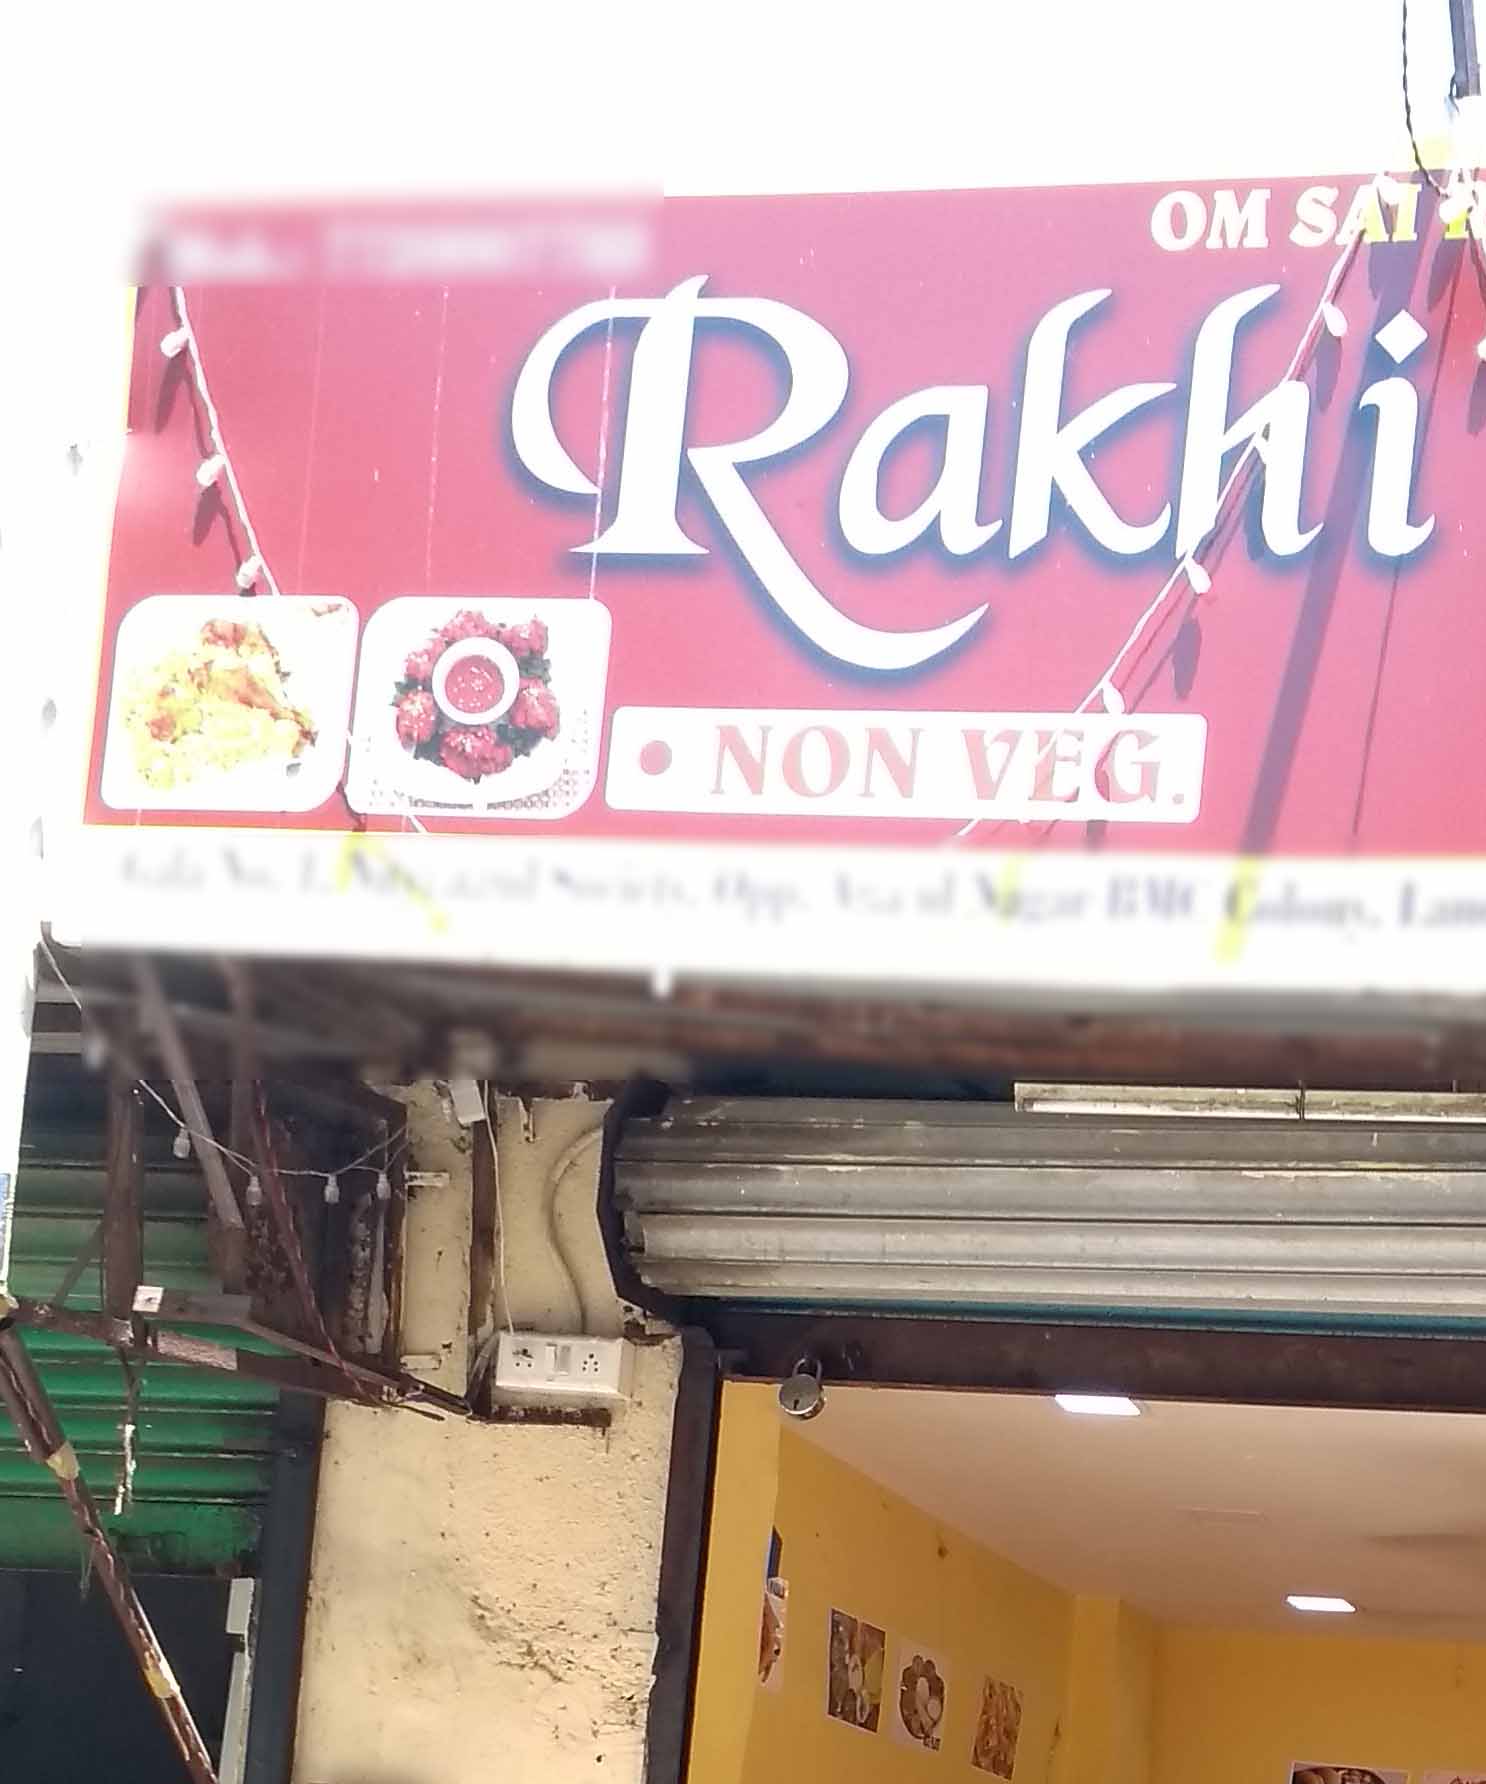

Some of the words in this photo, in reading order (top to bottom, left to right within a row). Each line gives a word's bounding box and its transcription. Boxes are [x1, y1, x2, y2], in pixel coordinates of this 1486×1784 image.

[1150, 188, 1272, 251] OM
[1288, 181, 1422, 247] SAI
[511, 273, 1436, 671] Rakhi
[710, 724, 925, 799] NON
[960, 728, 1186, 805] VEG.
